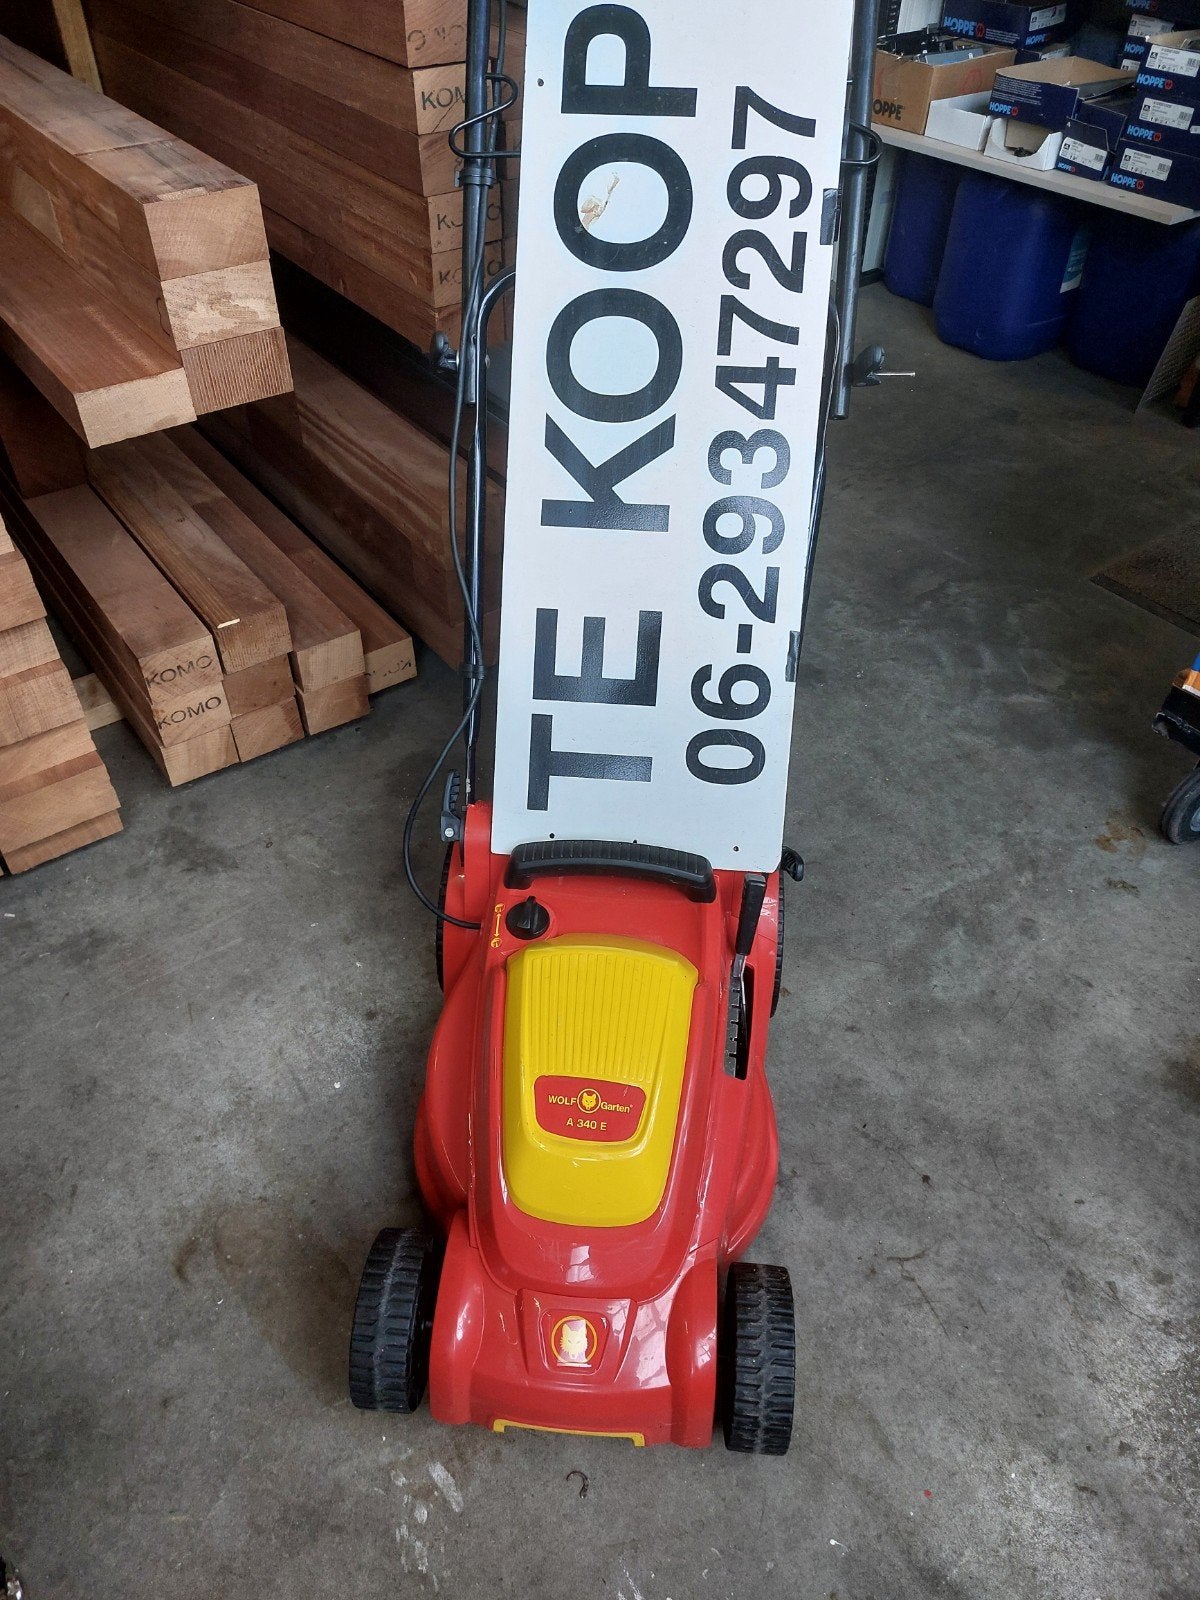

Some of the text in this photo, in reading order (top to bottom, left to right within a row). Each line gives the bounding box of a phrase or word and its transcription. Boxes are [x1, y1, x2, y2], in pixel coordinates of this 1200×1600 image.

[943, 16, 976, 36] HOPPE
[1124, 42, 1145, 55] HOPP
[1136, 73, 1166, 88] HOPPE
[872, 99, 905, 121] OPPE
[989, 101, 1012, 115] HOPPE
[1127, 124, 1154, 141] HOPPE
[1110, 172, 1138, 188] HOPPE
[527, 3, 697, 811] TE KOOP
[686, 86, 816, 786] 06-29347297
[145, 655, 213, 688] KOMO
[158, 696, 221, 729] KOMO
[548, 1094, 631, 1114] WOLF Garten
[566, 1117, 608, 1131] A 340 E
